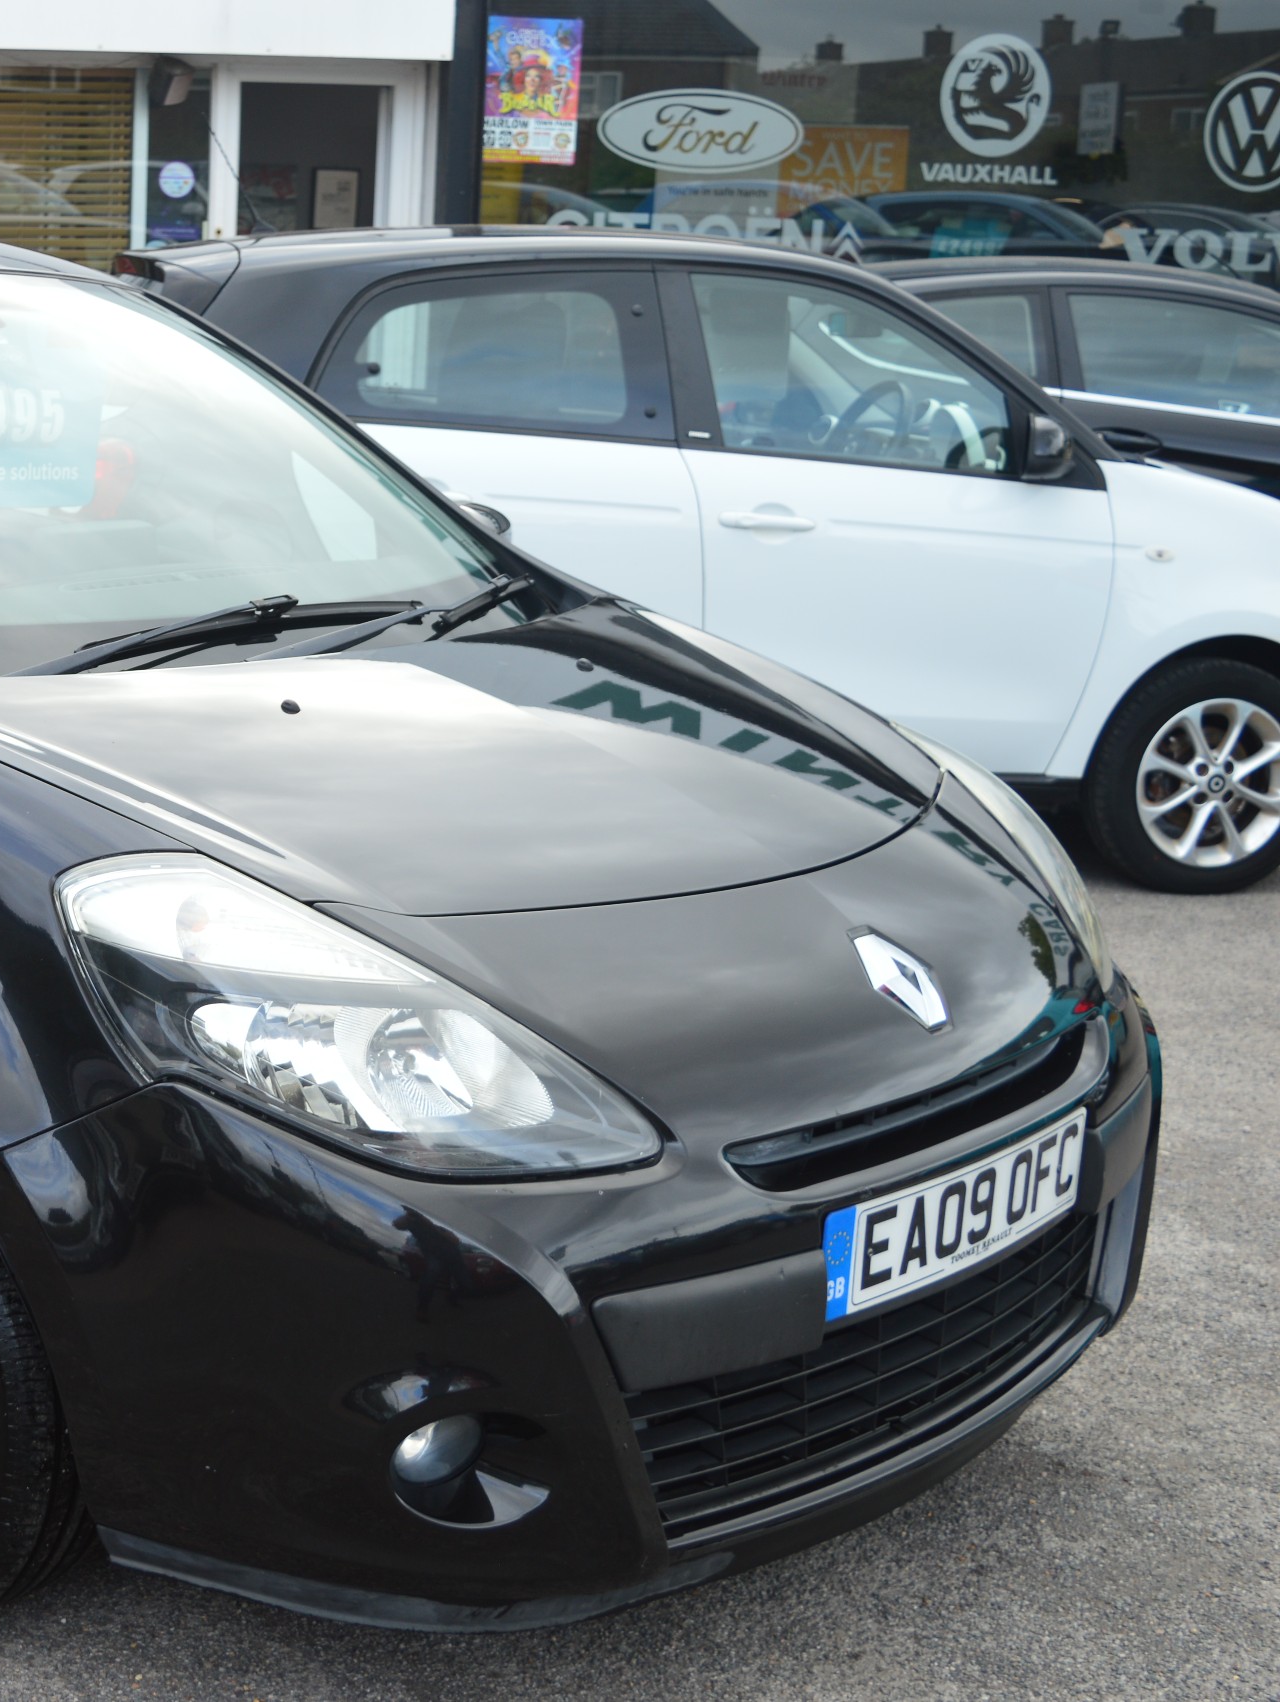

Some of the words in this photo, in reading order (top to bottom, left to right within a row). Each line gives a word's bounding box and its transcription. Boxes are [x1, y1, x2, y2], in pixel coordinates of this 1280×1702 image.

[642, 103, 759, 155] Ford
[791, 140, 895, 179] SAVE
[920, 162, 1058, 186] VAUXHALL
[1114, 227, 1280, 273] VOL
[10, 462, 80, 481] solutions
[860, 1166, 997, 1291] EA09
[1006, 1122, 1079, 1226] OFC
[826, 1276, 846, 1302] GB
